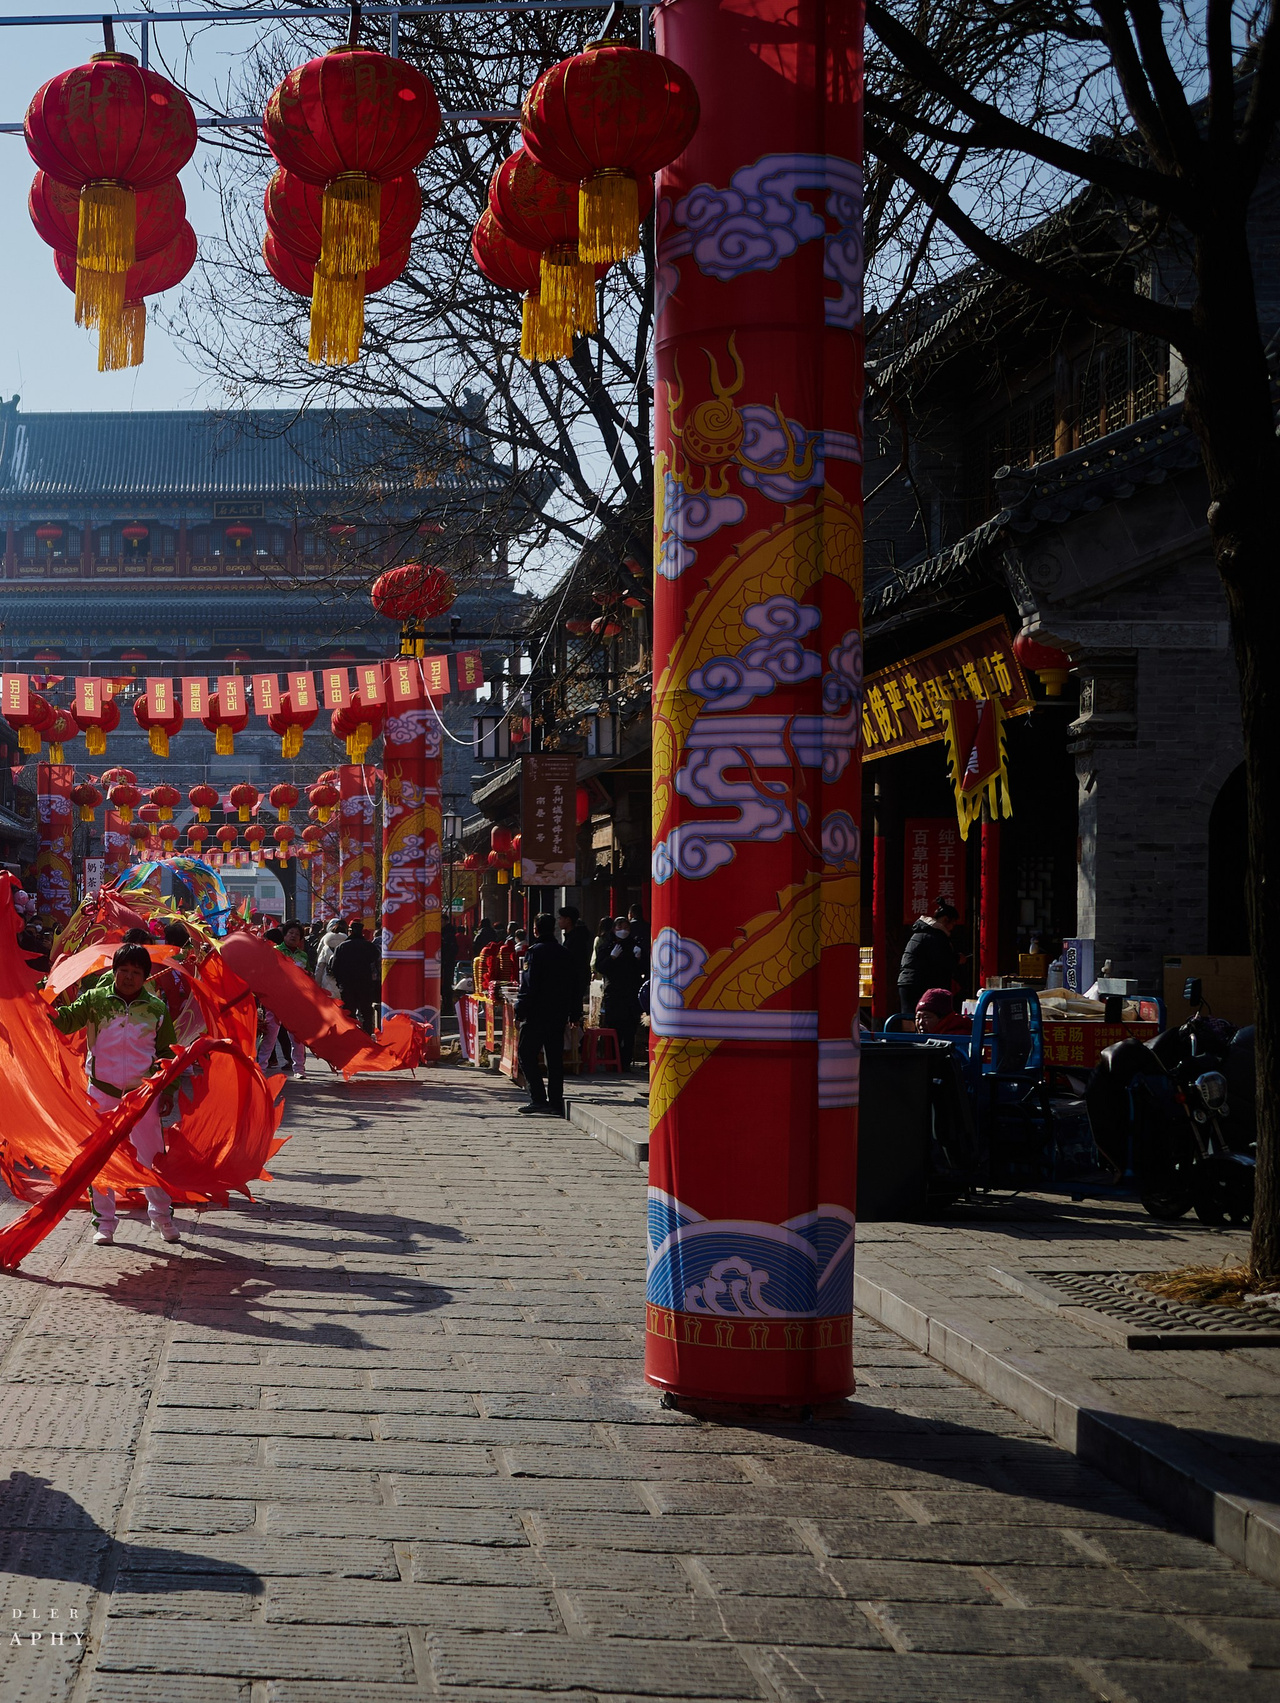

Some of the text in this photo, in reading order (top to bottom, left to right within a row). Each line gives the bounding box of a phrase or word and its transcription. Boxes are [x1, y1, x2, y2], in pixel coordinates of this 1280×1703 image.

[65, 80, 115, 130] 財
[912, 829, 929, 914] 百草梨膏糖
